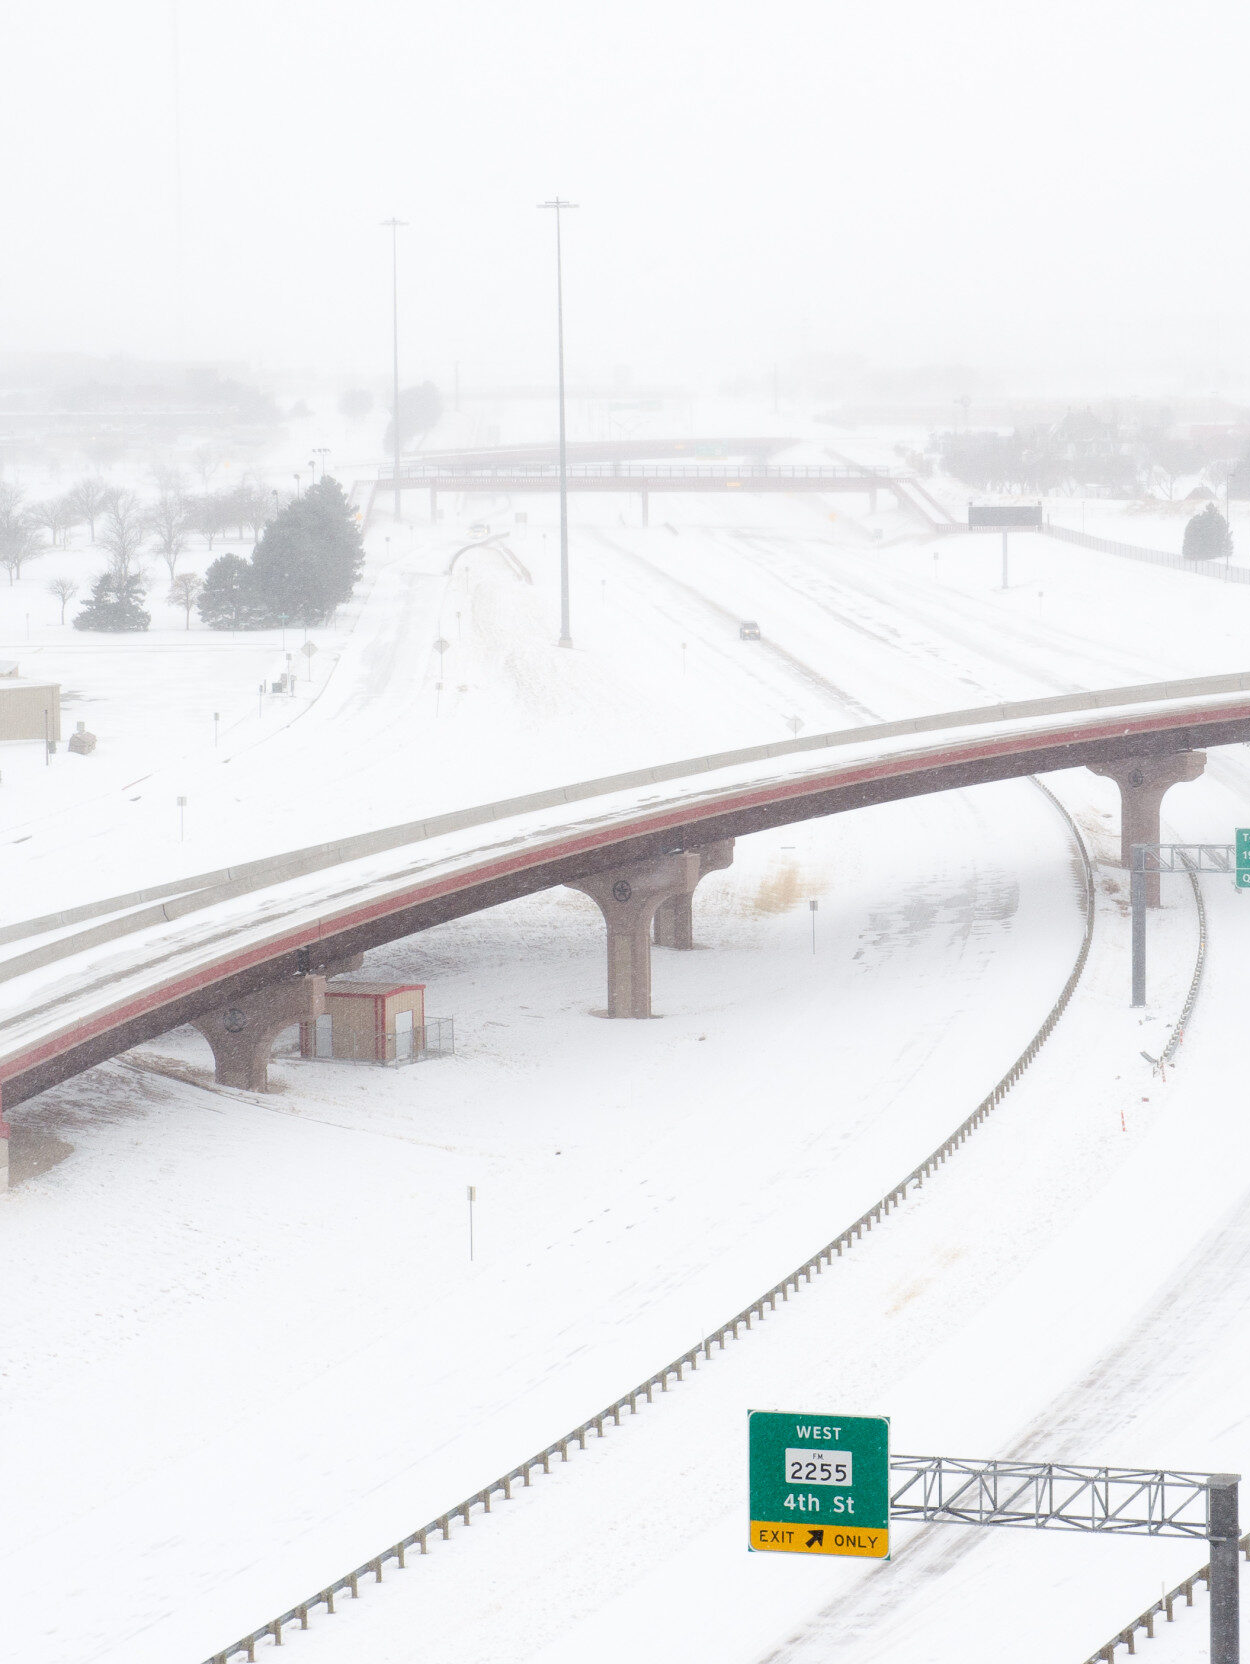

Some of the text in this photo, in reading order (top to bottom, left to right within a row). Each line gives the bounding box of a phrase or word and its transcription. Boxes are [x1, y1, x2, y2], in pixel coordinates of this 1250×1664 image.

[796, 1425, 842, 1440] WEST
[791, 1461, 847, 1482] 2255
[783, 1493, 855, 1514] 4th St
[759, 1530, 878, 1548] EXIT ONLY
